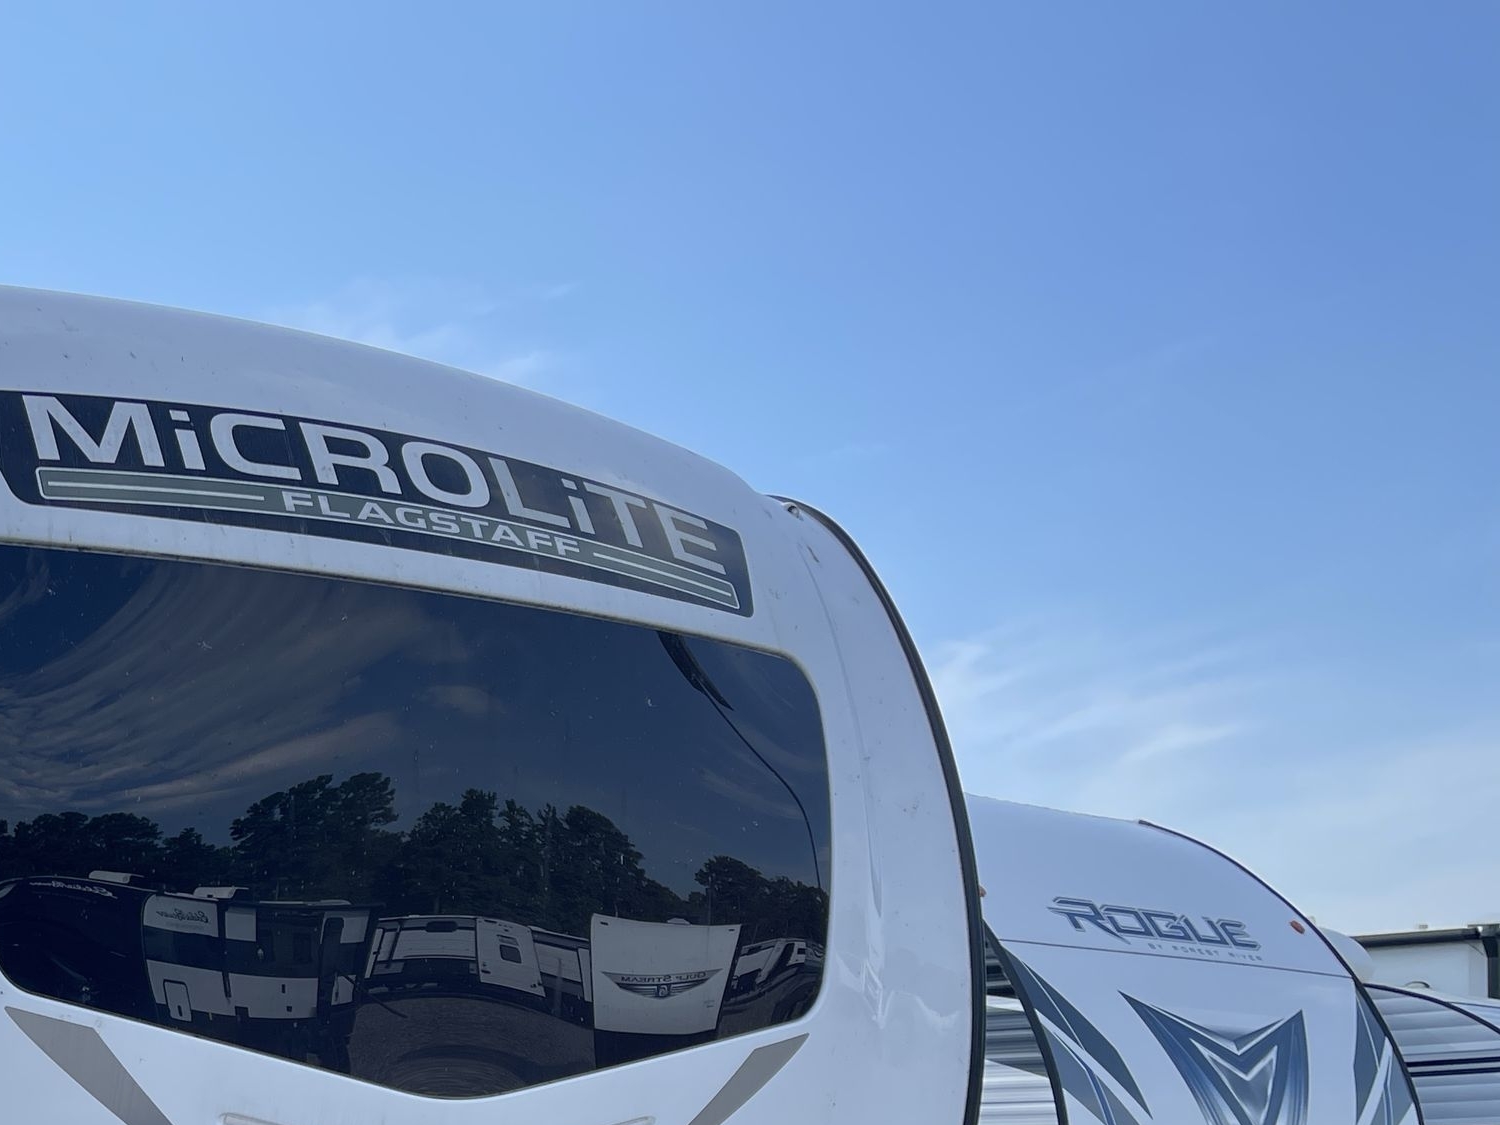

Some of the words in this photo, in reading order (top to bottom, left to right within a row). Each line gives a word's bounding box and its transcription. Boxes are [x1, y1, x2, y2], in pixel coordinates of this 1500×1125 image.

[21, 394, 727, 576] MiCROLiTE
[281, 489, 582, 560] FLAGSTAFF
[1046, 895, 1262, 952] ROGUE
[1172, 945, 1220, 956] FOREST
[1229, 950, 1264, 961] RIVER
